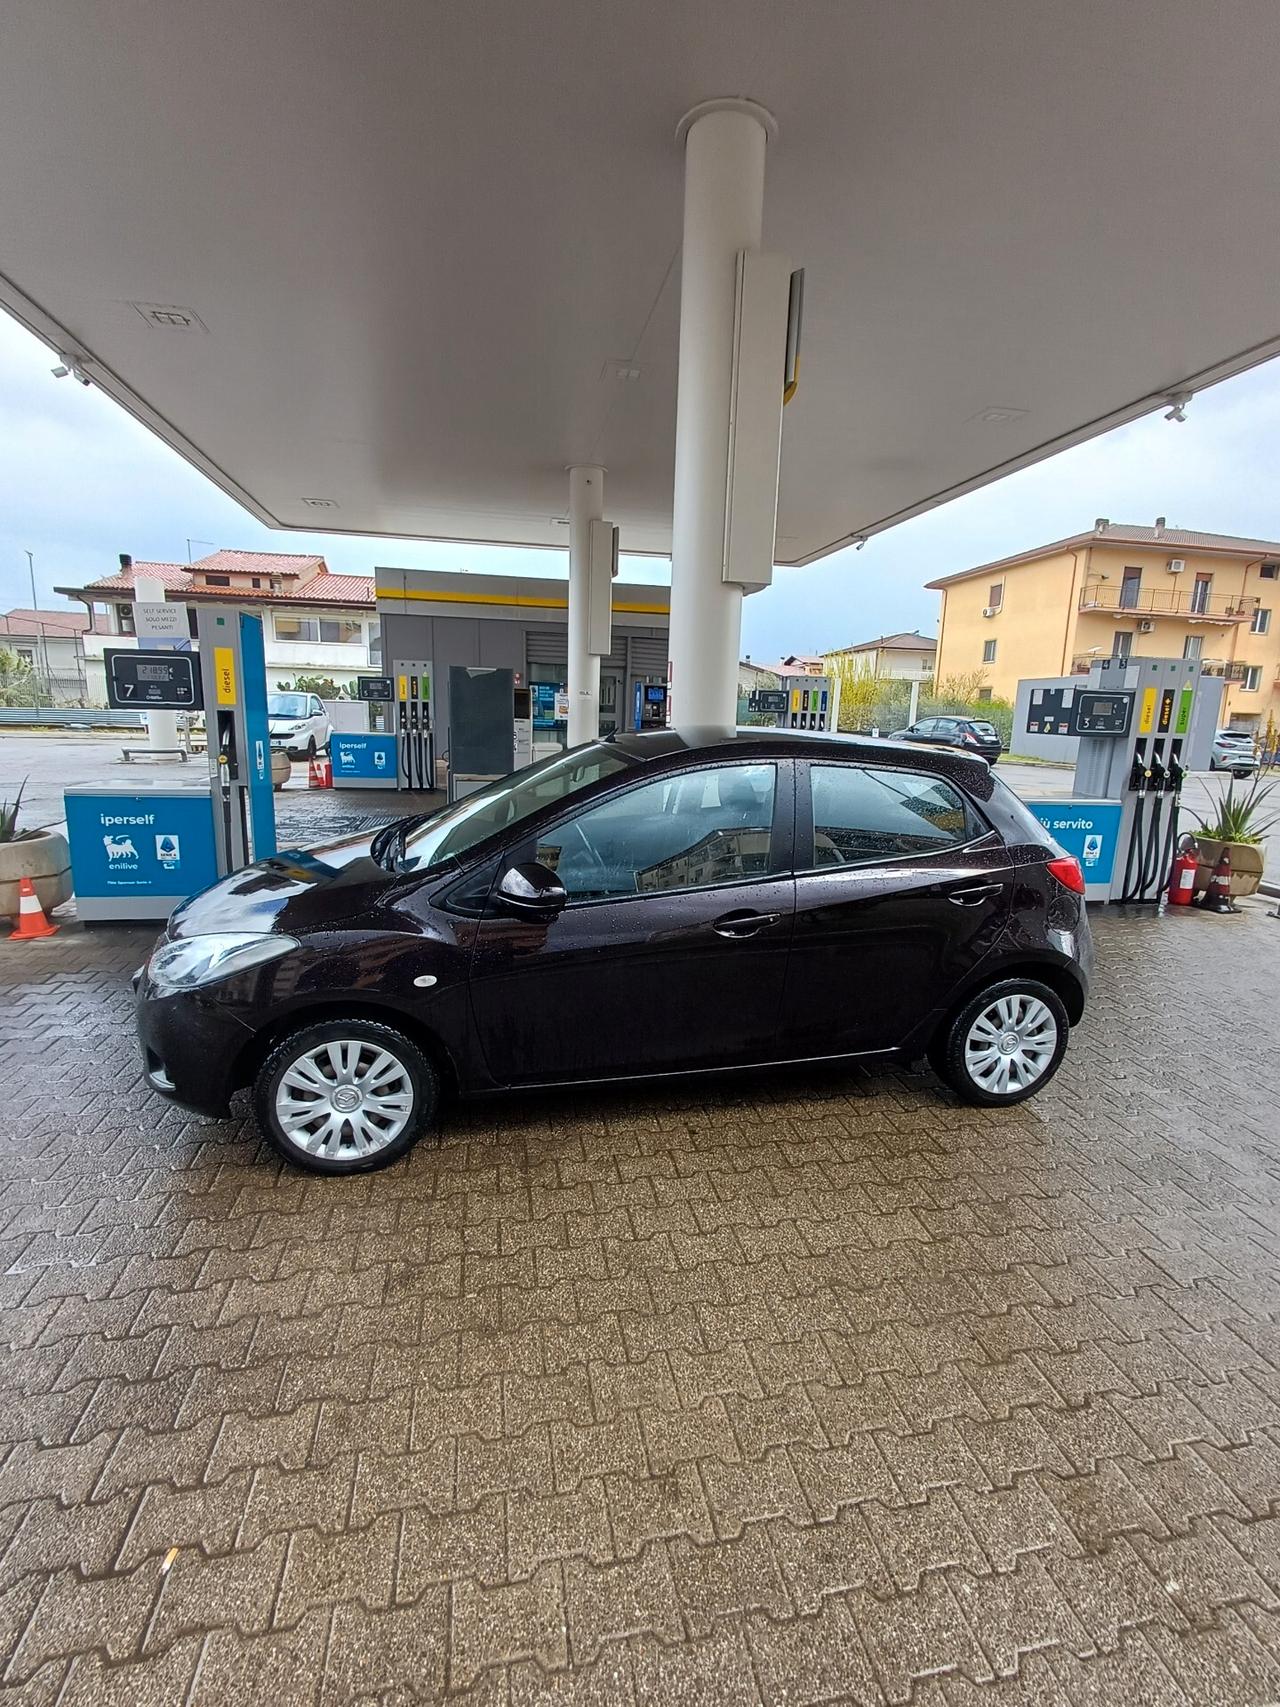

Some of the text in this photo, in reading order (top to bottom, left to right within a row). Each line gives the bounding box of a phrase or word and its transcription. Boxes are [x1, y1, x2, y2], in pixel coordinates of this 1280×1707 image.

[223, 668, 231, 694] diesel
[124, 684, 134, 697] 7
[1083, 717, 1090, 729] 3
[339, 741, 367, 750] iperself
[100, 813, 155, 827] iperself
[1040, 817, 1093, 829] iù servito
[108, 862, 138, 870] enilive
